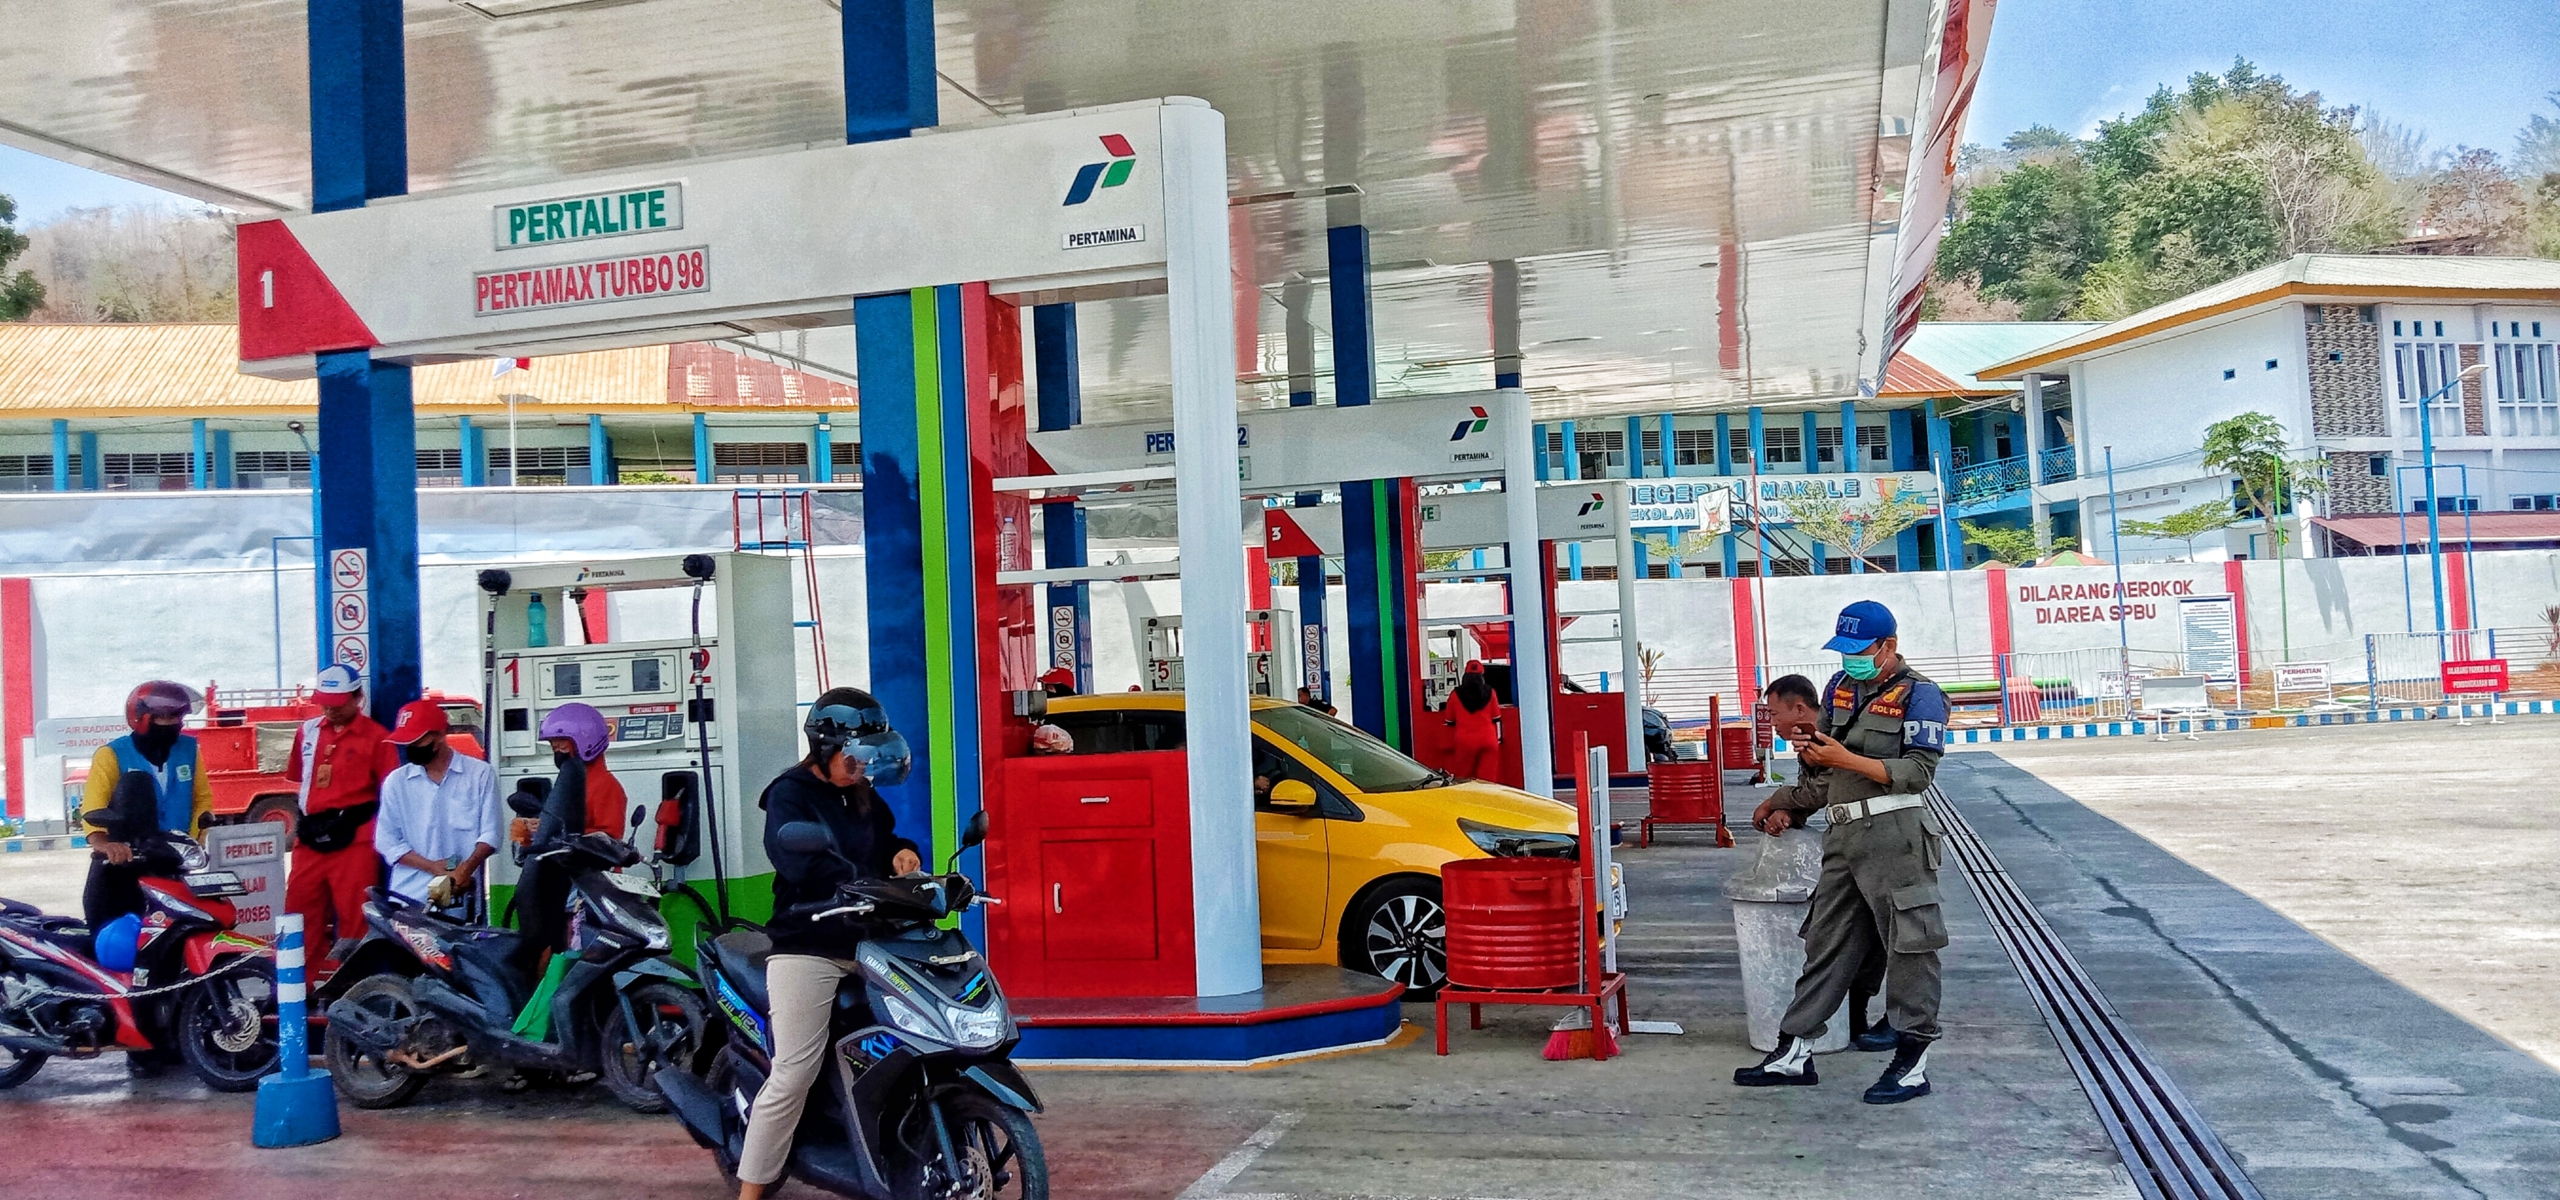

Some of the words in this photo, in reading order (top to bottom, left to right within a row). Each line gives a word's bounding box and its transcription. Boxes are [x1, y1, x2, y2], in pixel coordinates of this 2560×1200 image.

[509, 190, 666, 244] PERTALITE
[1069, 227, 1137, 247] PERTAMINA
[260, 269, 275, 308] 1
[476, 264, 595, 312] PERTAMAX
[596, 255, 674, 298] TURBO
[677, 250, 705, 290] 98
[1454, 452, 1490, 461] PERTAMINA
[1630, 507, 1695, 521] EKOLAH
[1271, 526, 1282, 541] 3
[2020, 583, 2110, 602] DILARANG
[2112, 579, 2194, 599] MEROKOK
[2109, 603, 2156, 621] SPBU
[1837, 615, 1861, 634] PTI
[689, 648, 711, 684] 2
[1158, 660, 1170, 680] 5
[504, 658, 520, 696] 1
[1872, 704, 1888, 714] POL
[1890, 707, 1902, 716] PP
[65, 726, 80, 734] AIR
[82, 724, 128, 733] RADIATOR
[1903, 720, 1947, 748] PT
[225, 841, 273, 859] PERTALITE
[242, 876, 267, 892] ALAM
[237, 905, 270, 923] ROSES
[864, 955, 889, 976] YAMAHA
